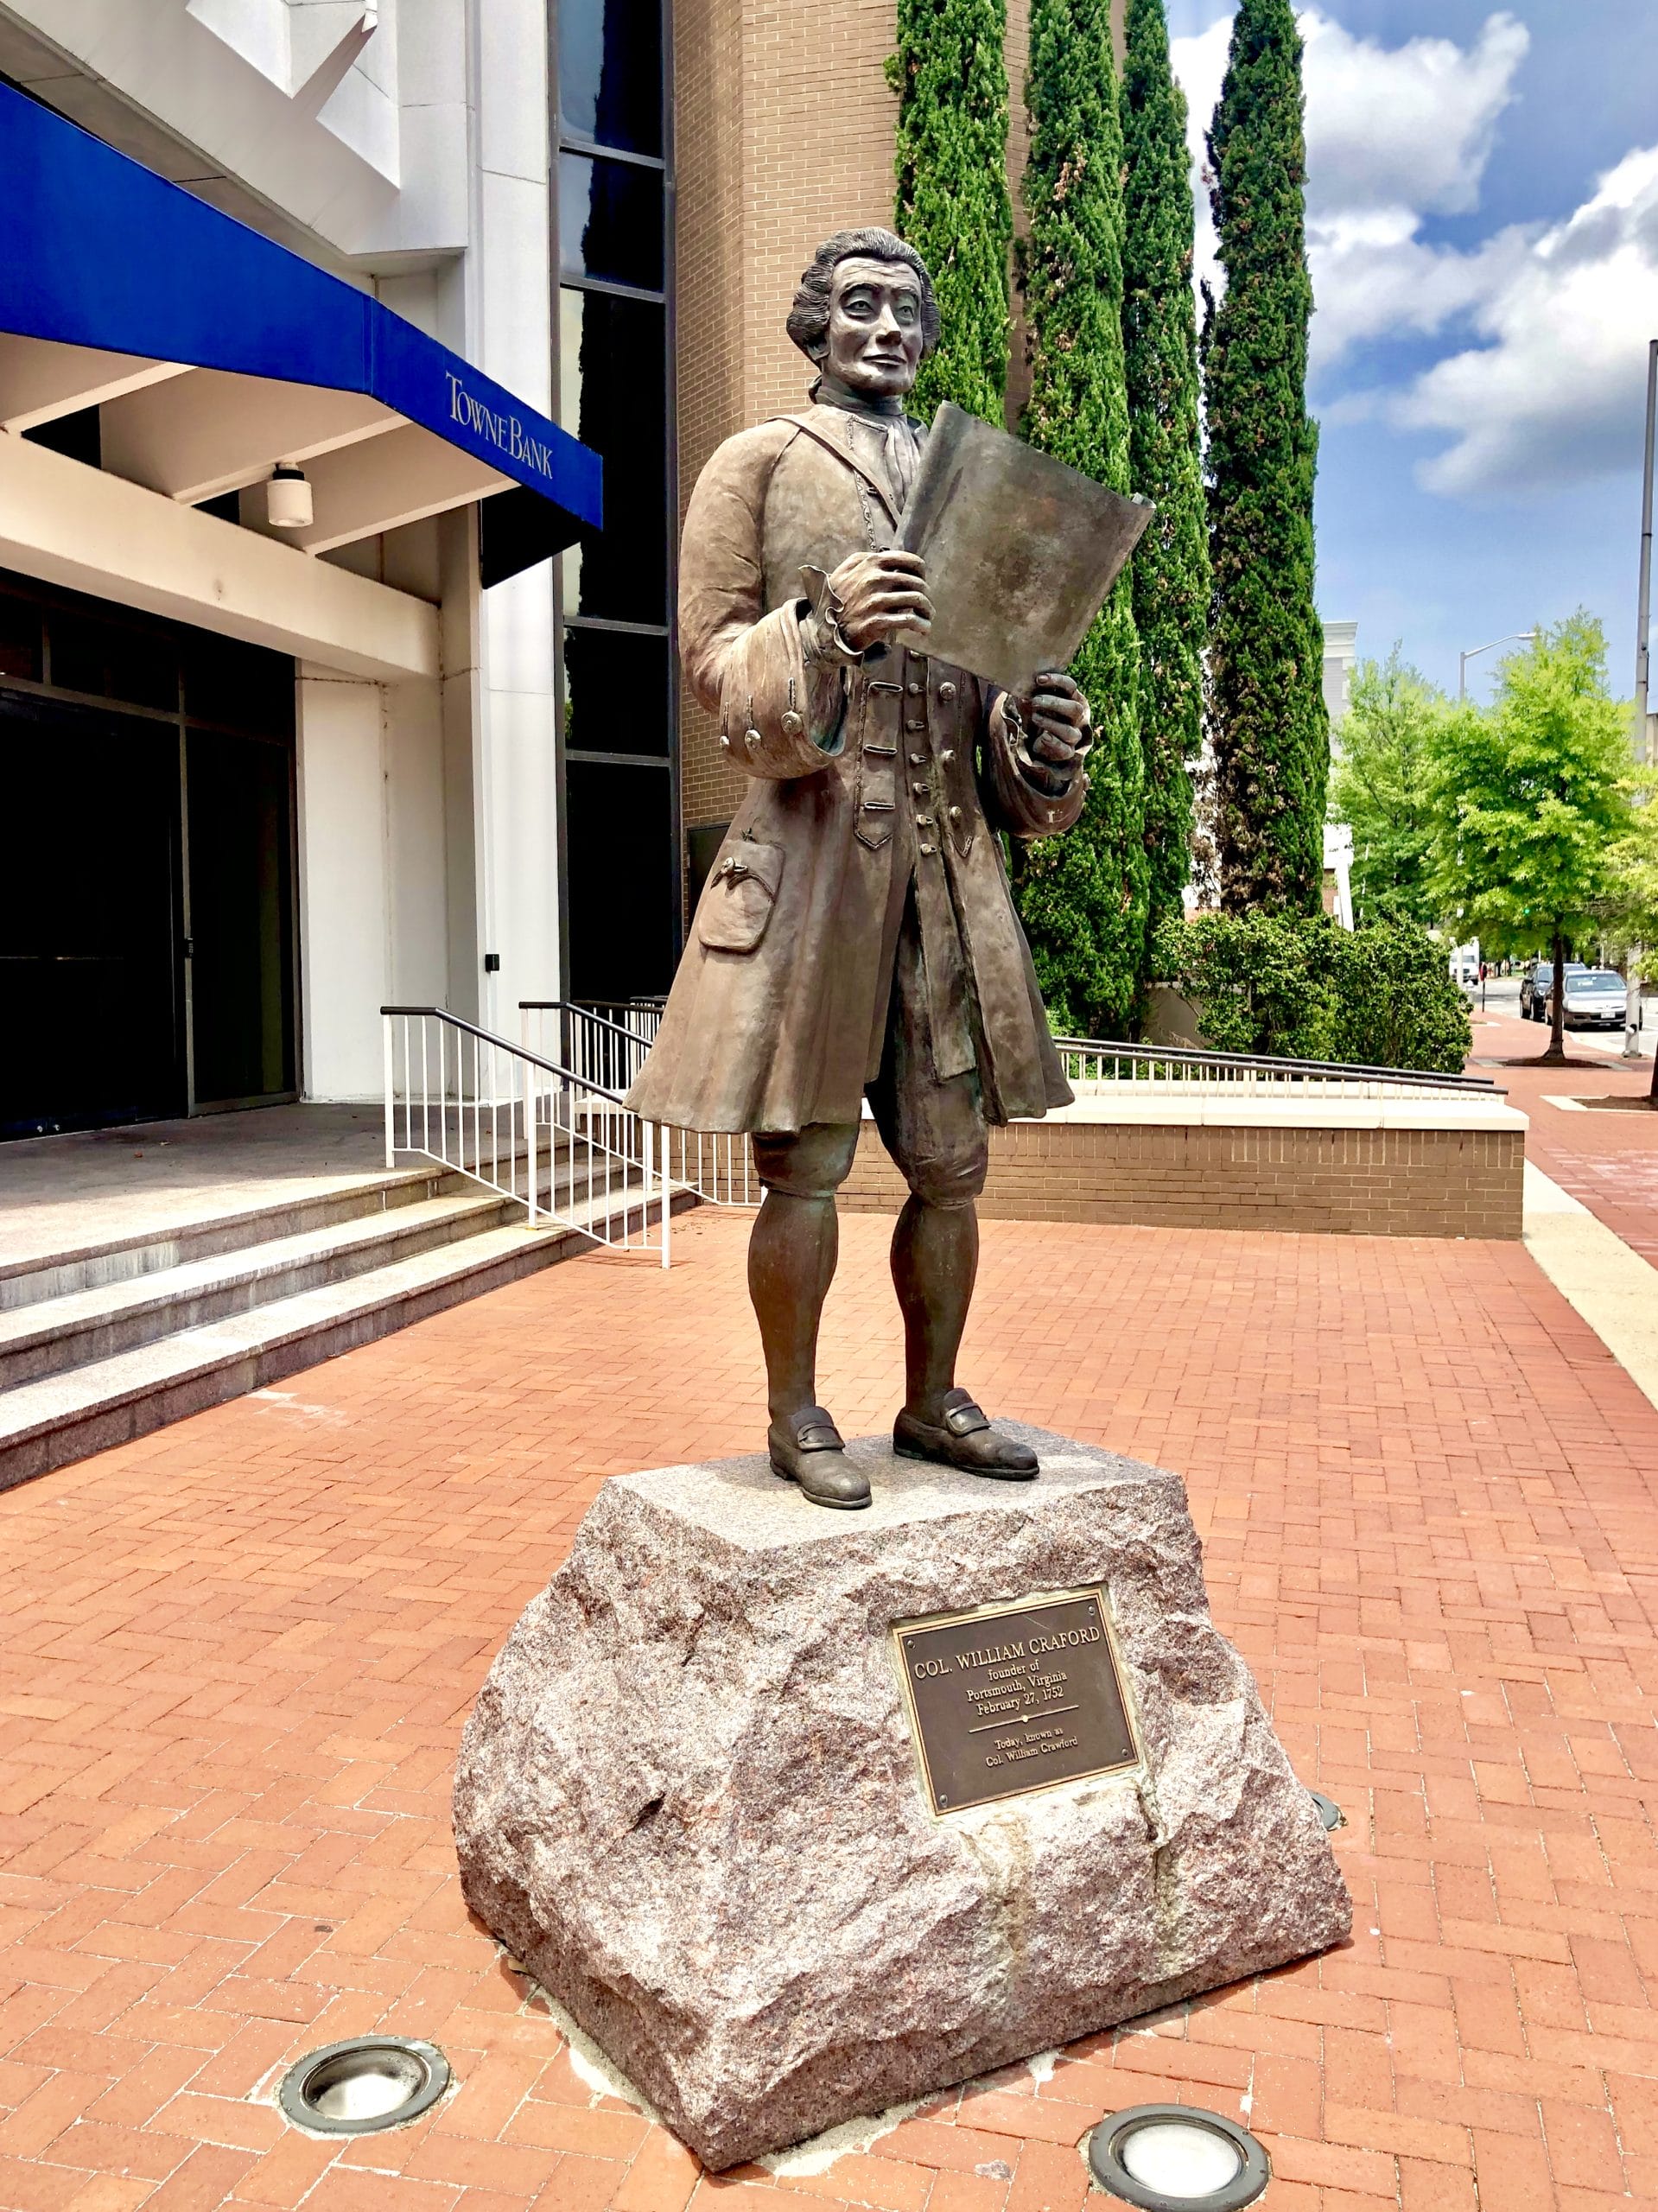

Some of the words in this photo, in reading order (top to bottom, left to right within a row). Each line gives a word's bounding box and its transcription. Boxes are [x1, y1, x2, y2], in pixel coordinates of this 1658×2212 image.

[914, 1659, 953, 1679] COL.
[956, 1642, 1026, 1669] WILLIAM
[1029, 1626, 1100, 1654] CRAFORD
[988, 1664, 1026, 1681] founder
[1030, 1659, 1039, 1671] of
[966, 1680, 1026, 1701] Portsmouth,
[1027, 1671, 1068, 1688] Virginia
[976, 1697, 1020, 1715] February
[1023, 1692, 1039, 1705] 27,
[1043, 1686, 1064, 1700] 1752
[994, 1737, 1023, 1751] Today,
[1025, 1730, 1052, 1743] known
[1054, 1727, 1064, 1736] as
[1006, 1747, 1039, 1761] William
[1040, 1736, 1078, 1753] Crawford
